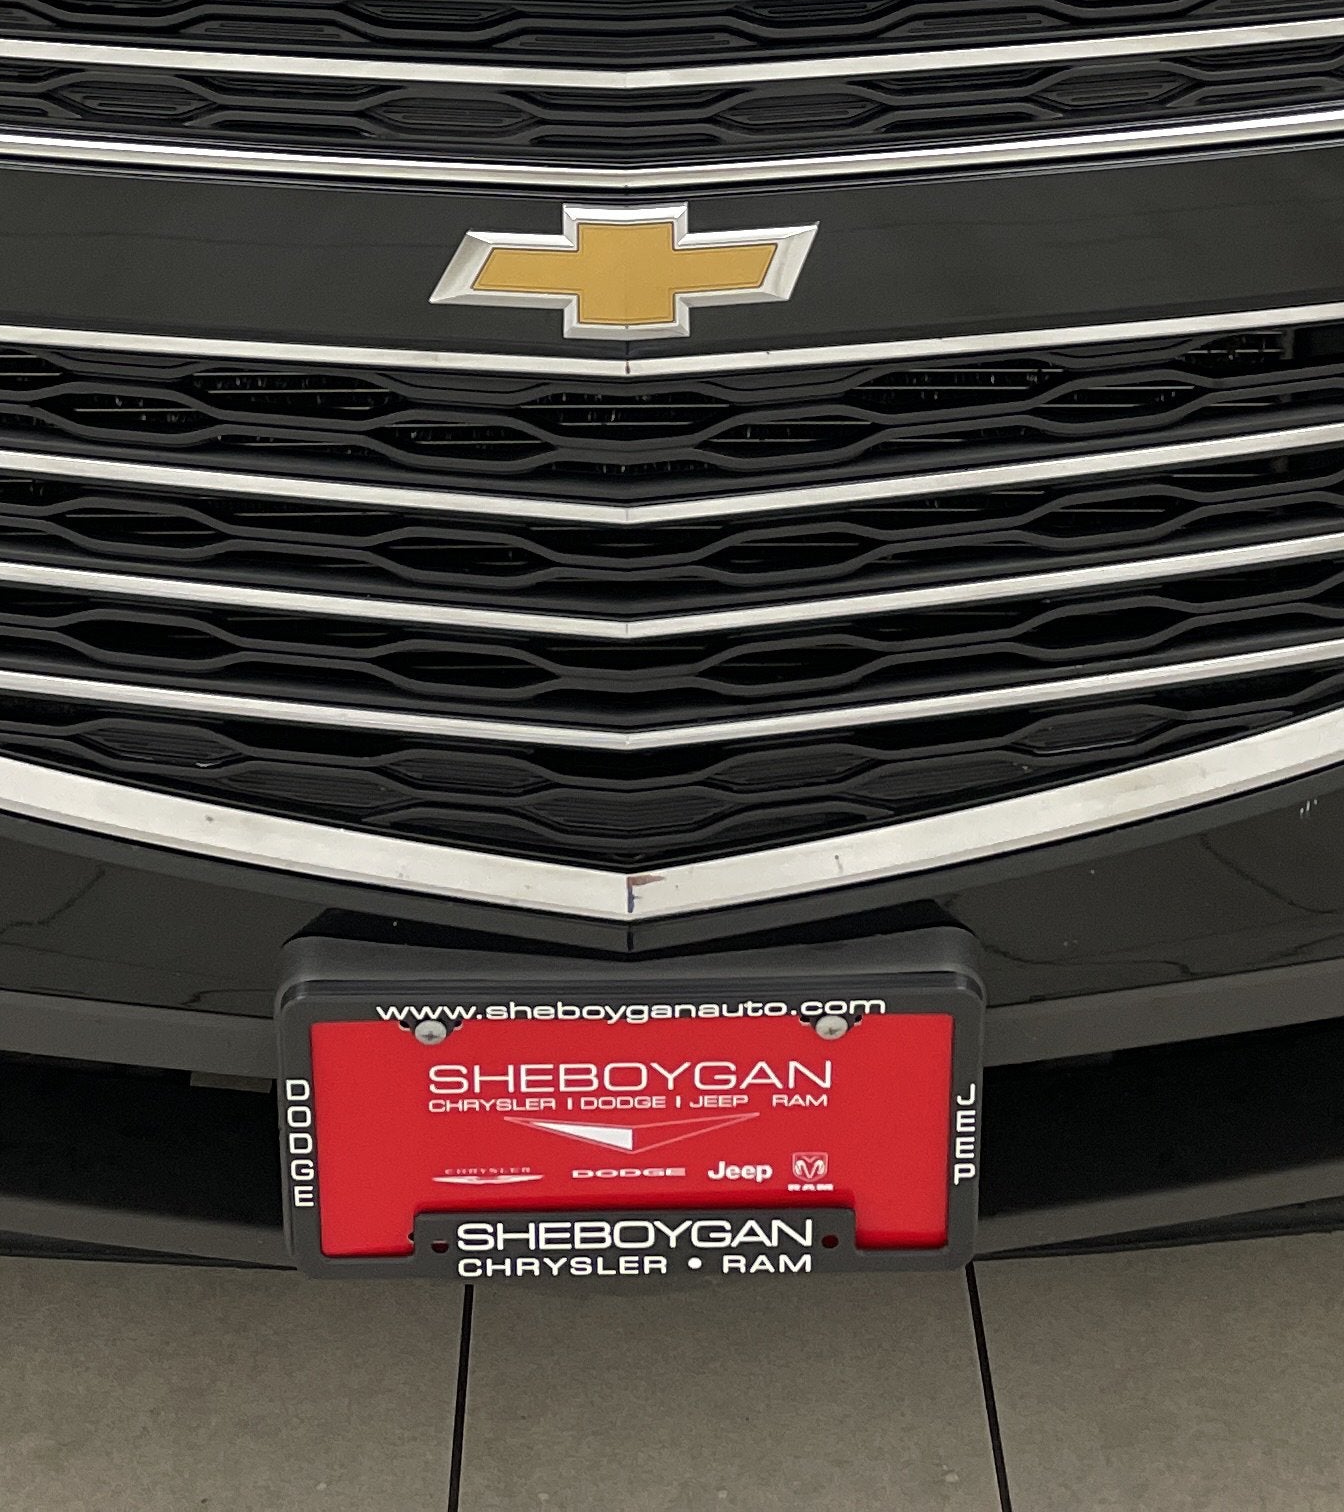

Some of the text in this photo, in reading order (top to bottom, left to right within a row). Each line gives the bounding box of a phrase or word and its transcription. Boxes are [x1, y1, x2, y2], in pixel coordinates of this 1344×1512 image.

[375, 999, 886, 1024] www.sheboyganauto.com
[428, 1059, 832, 1094] SHEBOYGAN
[428, 1093, 828, 1113] CHRYSLER DODGE JEEP RAM
[285, 1079, 315, 1207] DODGE
[954, 1083, 976, 1186] JEEP
[707, 1160, 773, 1183] Jeep
[457, 1219, 813, 1251] SHEBOYGAN
[457, 1254, 812, 1277] CHRYSLER RAM
